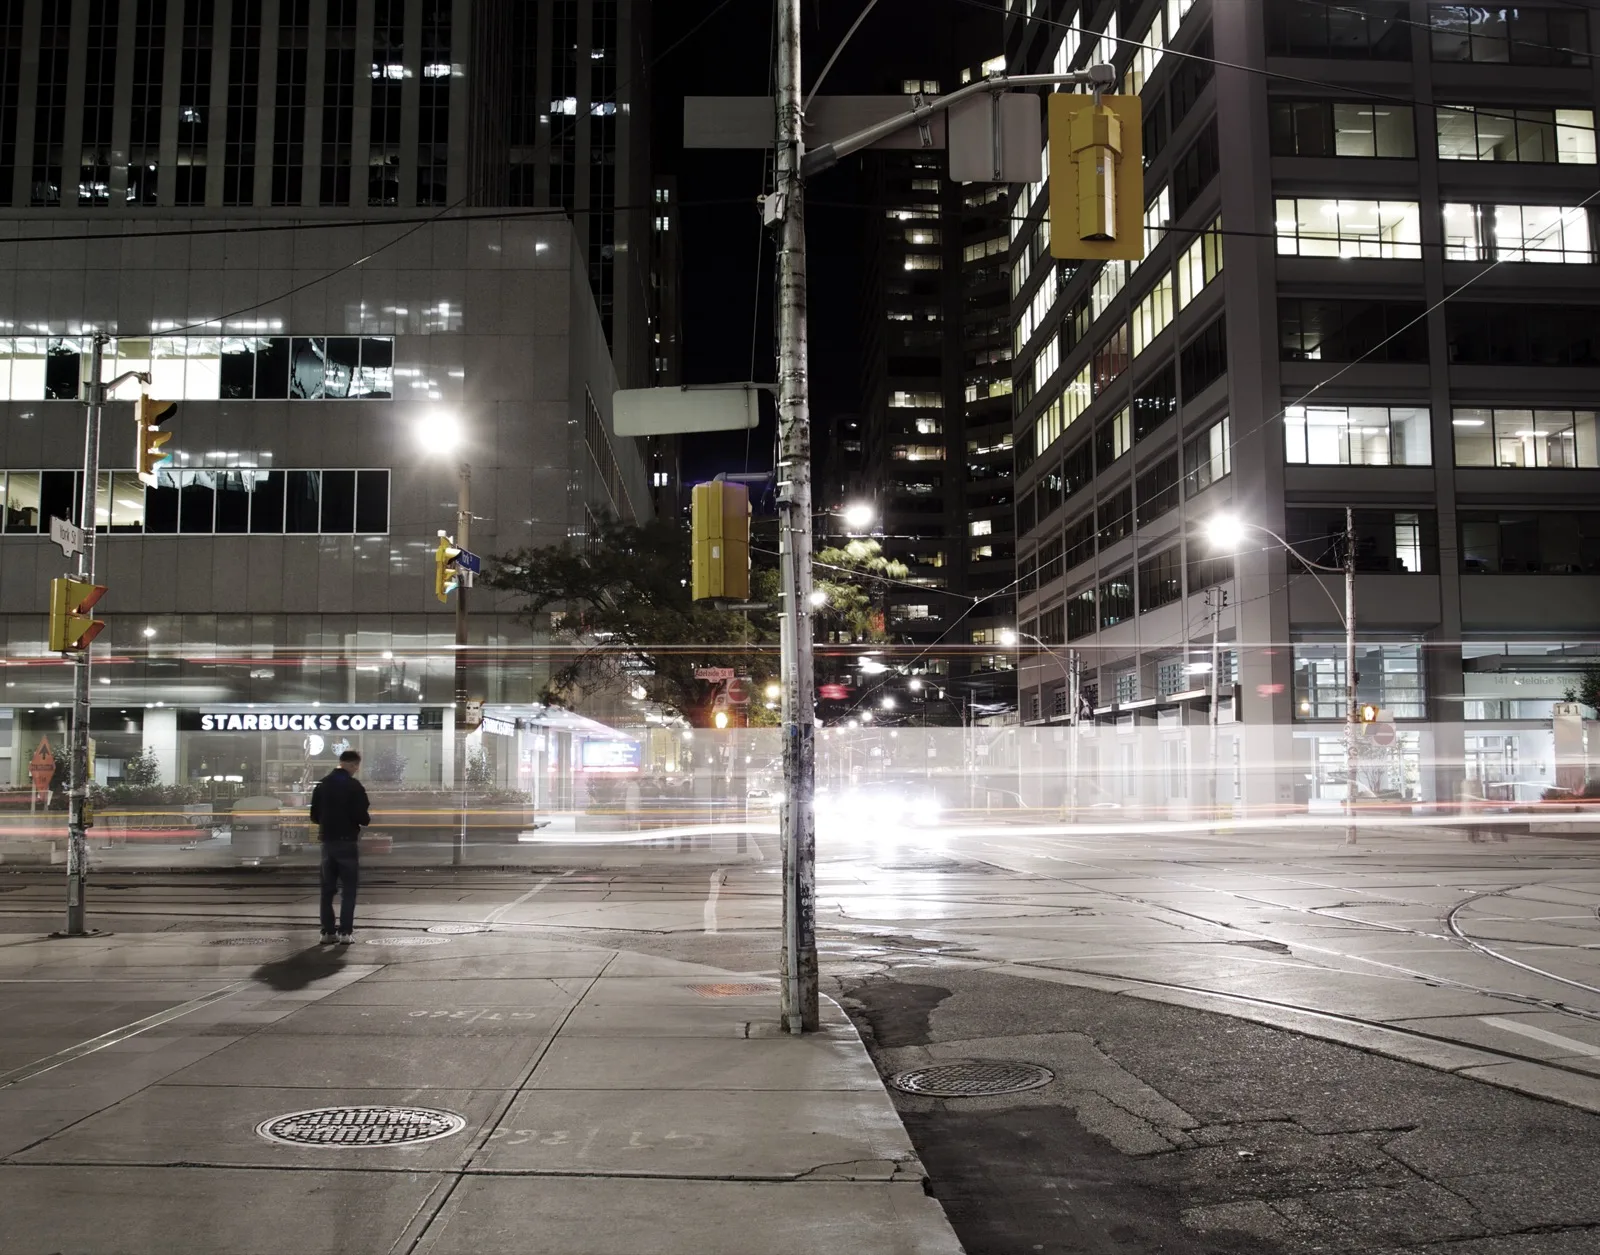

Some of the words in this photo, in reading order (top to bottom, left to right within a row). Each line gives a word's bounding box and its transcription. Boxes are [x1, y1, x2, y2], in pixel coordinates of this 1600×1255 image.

[695, 669, 719, 677] Adelaide
[720, 669, 726, 677] St
[1494, 676, 1508, 685] 141
[1511, 676, 1554, 685] Adelaide
[1556, 705, 1579, 715] 141
[201, 714, 332, 731] STARBUCKS
[336, 714, 419, 731] COFFEE
